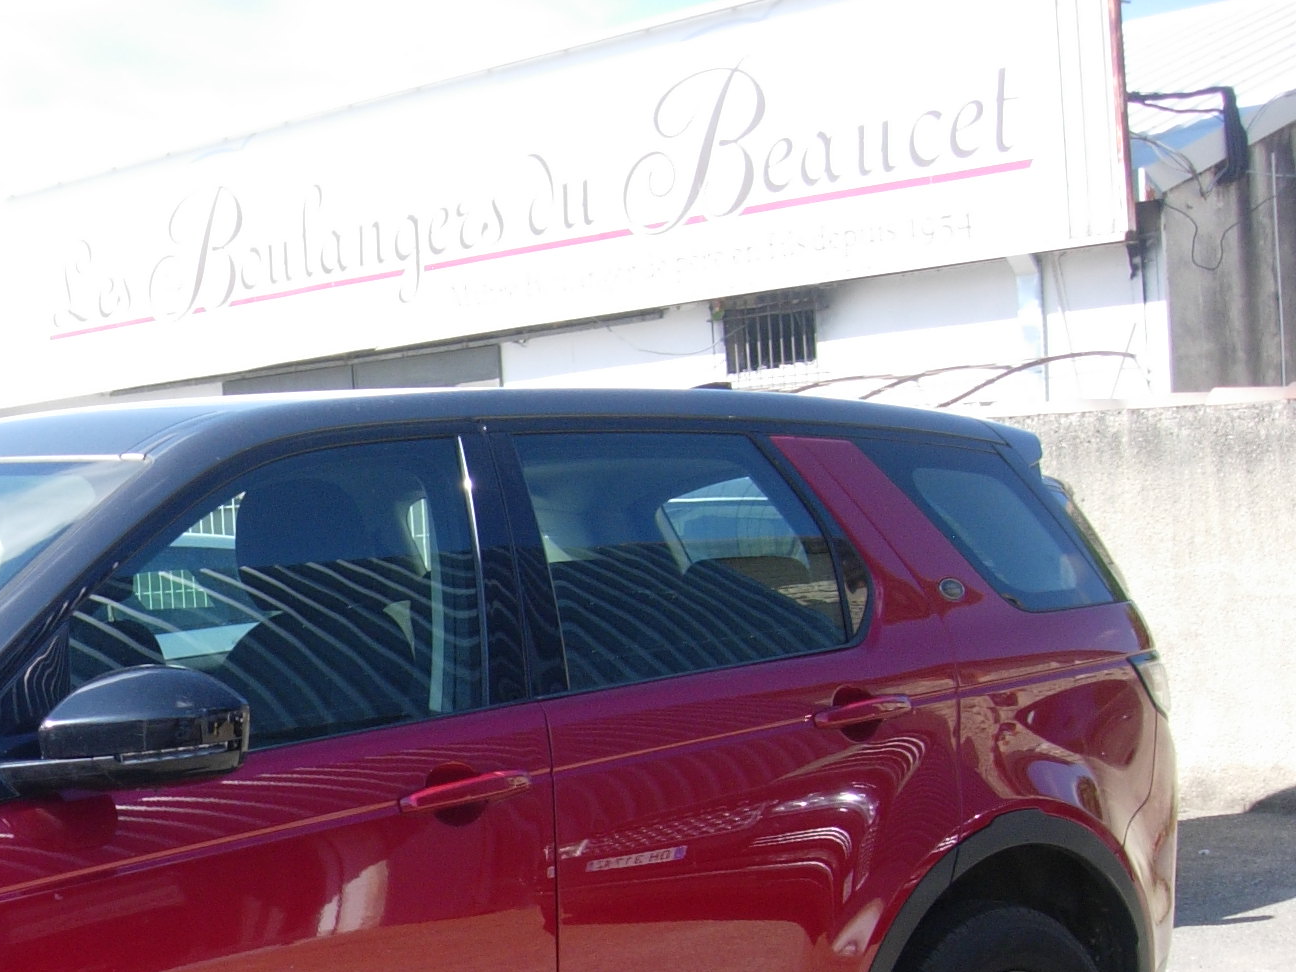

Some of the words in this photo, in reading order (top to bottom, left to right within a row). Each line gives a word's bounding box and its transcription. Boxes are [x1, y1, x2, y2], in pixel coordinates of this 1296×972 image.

[53, 239, 131, 327] Les
[149, 184, 504, 322] Boulangers
[527, 153, 595, 236] du
[623, 54, 1019, 236] Beaucet
[907, 210, 975, 245] 1954
